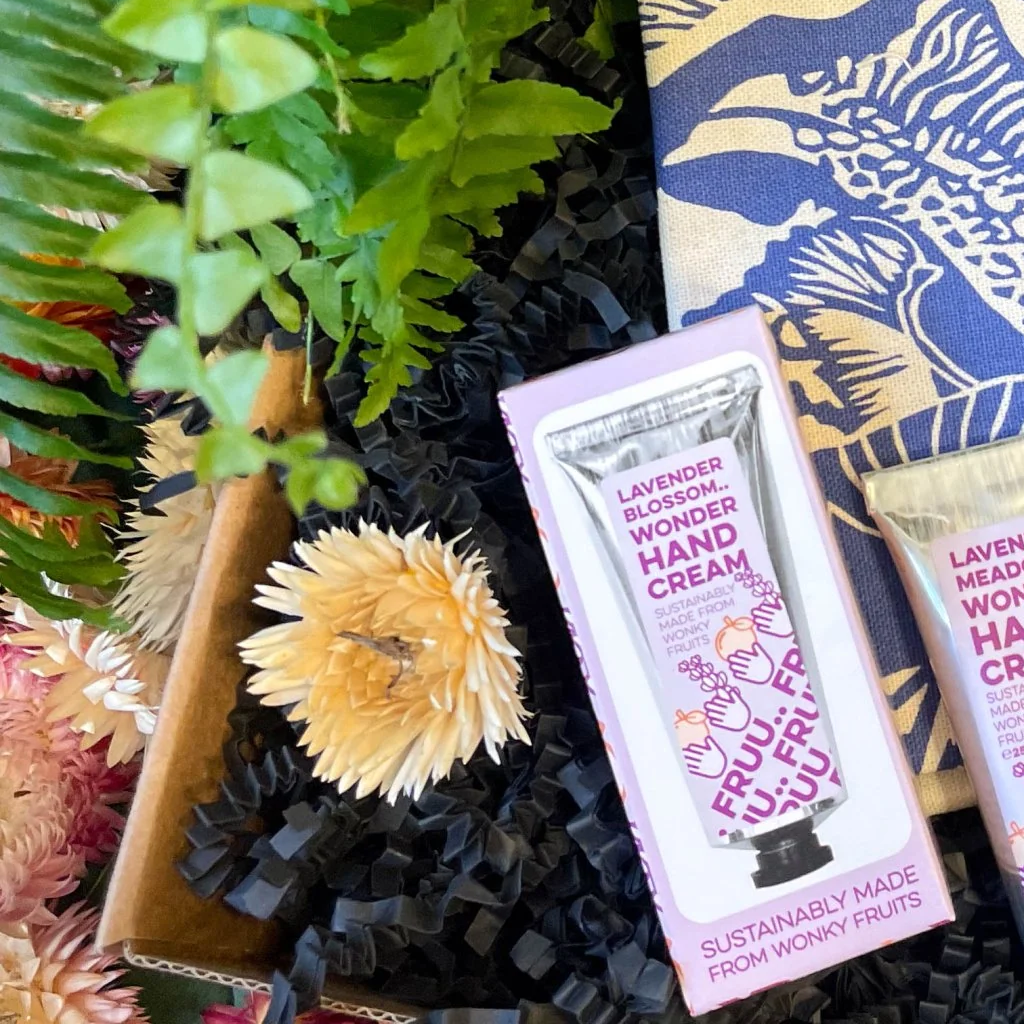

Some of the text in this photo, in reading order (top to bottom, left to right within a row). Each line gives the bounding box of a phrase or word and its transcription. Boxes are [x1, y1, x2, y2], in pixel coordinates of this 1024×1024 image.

[617, 456, 724, 504] LAVENDER
[623, 479, 729, 523] BLOSSOM..
[629, 496, 738, 545] WONDER
[638, 522, 737, 575] HAND
[647, 548, 750, 599] CREAM
[654, 582, 735, 619] SUSTAINABLY
[658, 597, 735, 632] MADE FROM
[662, 619, 710, 644] WONKY
[666, 634, 711, 657] FRUITS
[700, 864, 920, 959] SUSTAINABLY MADE
[708, 891, 923, 983] FROM WONKY FRUITS
